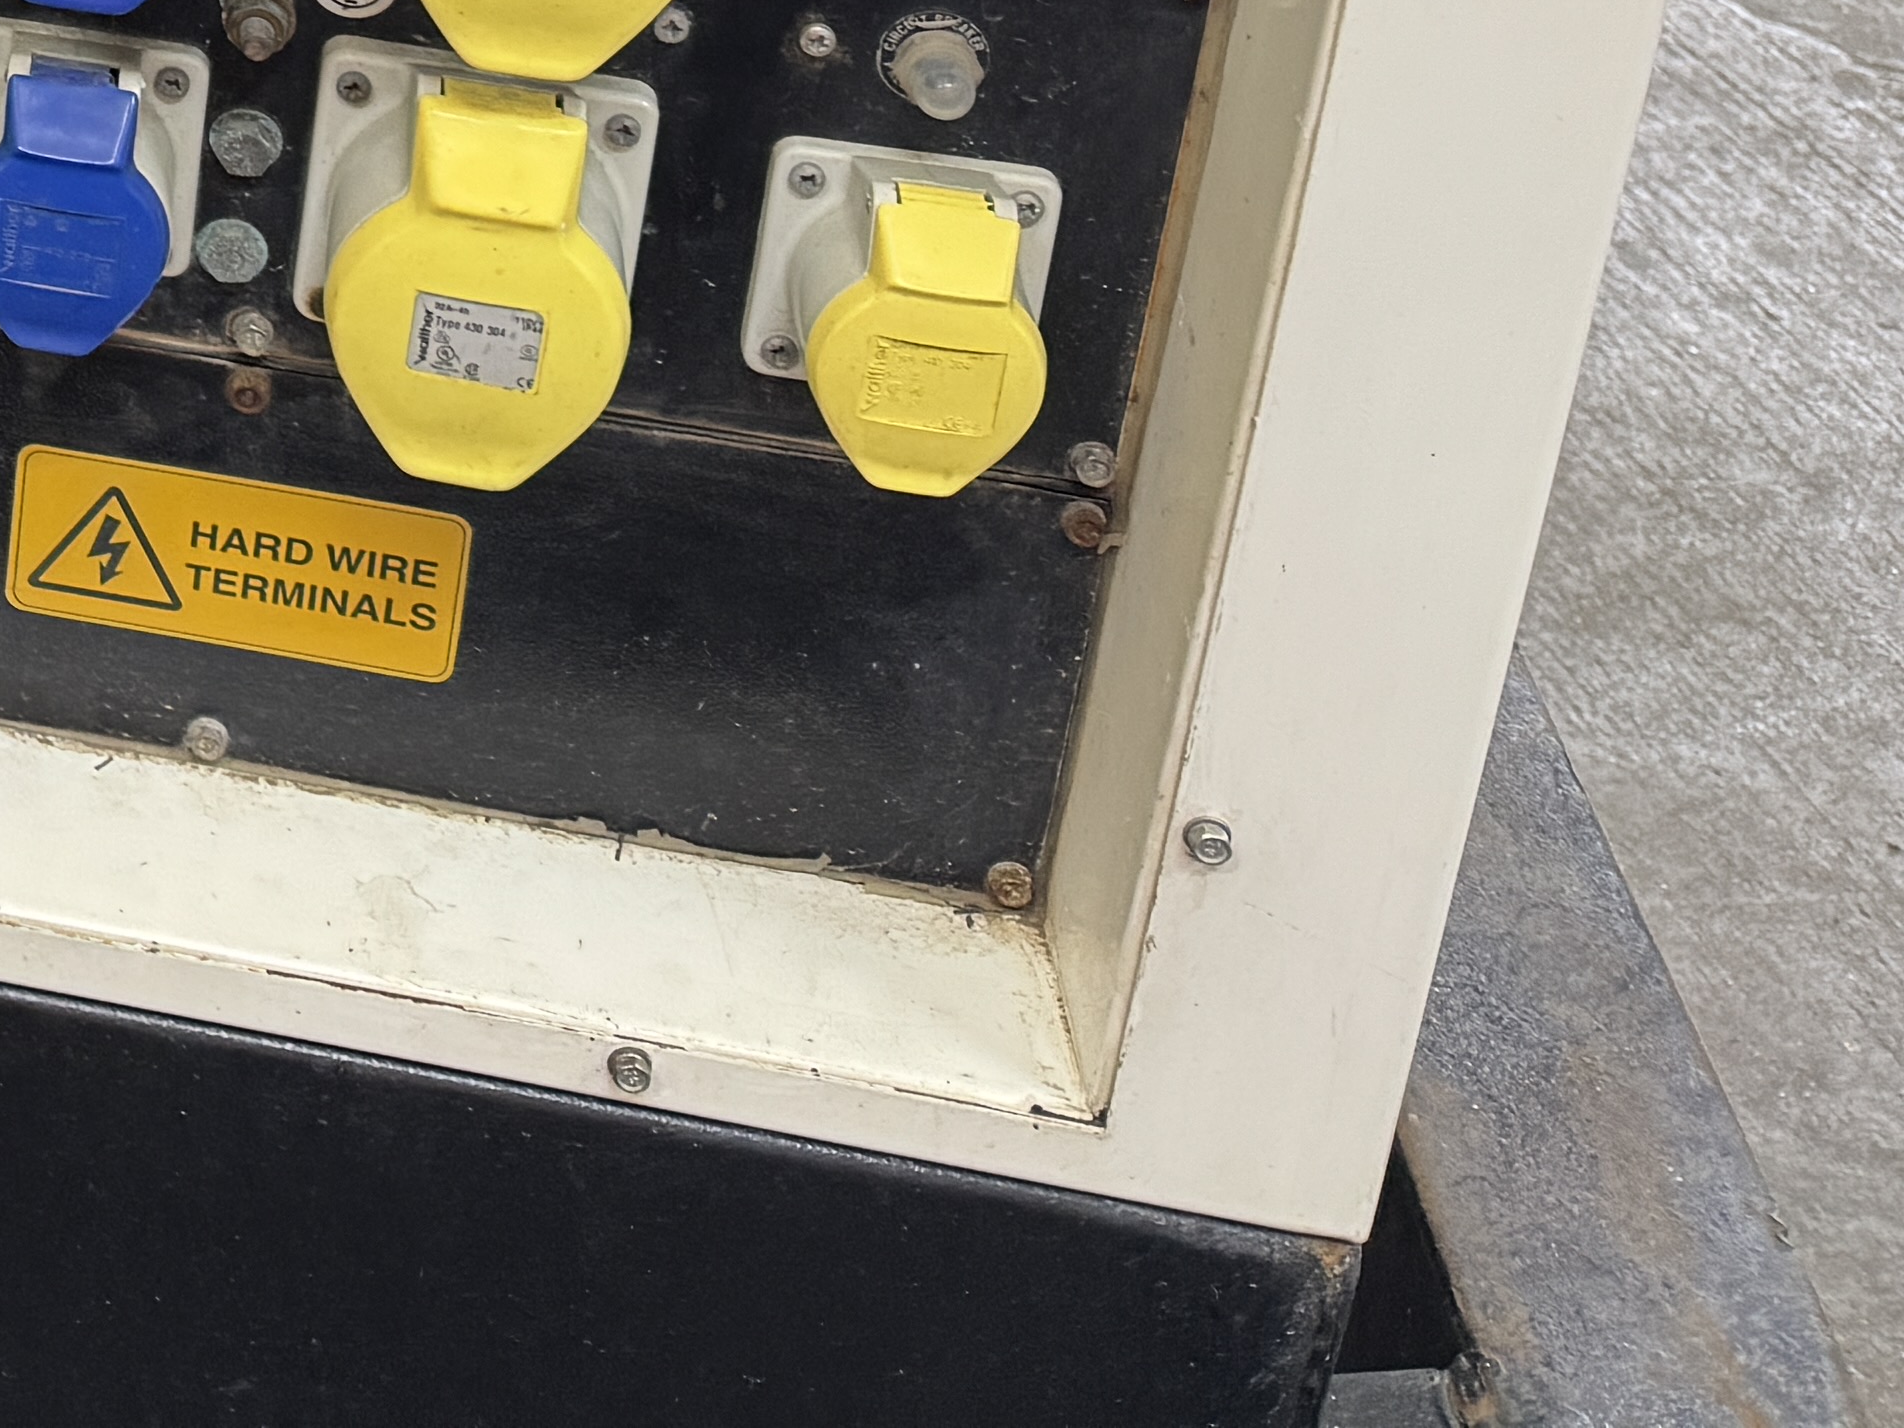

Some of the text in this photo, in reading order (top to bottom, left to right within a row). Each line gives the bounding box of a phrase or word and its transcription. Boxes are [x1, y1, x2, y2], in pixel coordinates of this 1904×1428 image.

[190, 521, 439, 589] HARD WIRE
[184, 562, 437, 631] TERMINALS
